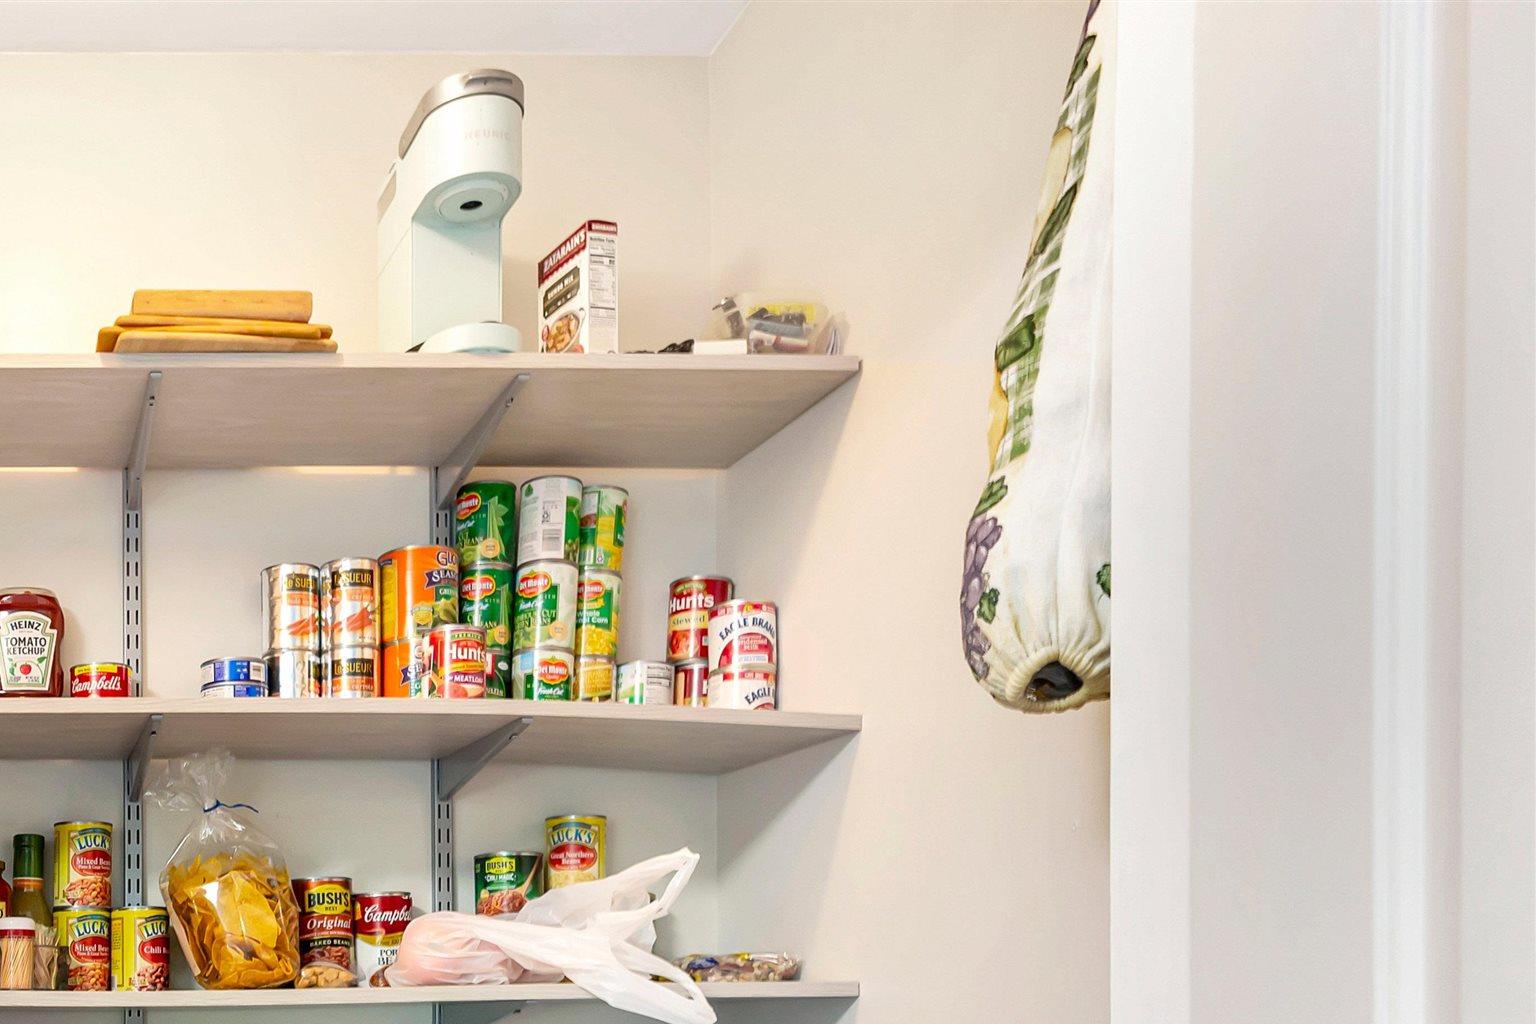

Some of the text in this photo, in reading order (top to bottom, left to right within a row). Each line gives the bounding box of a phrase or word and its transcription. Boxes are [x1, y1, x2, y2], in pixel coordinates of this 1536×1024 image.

[436, 551, 456, 566] Glo
[10, 620, 42, 631] HEINZ
[672, 614, 706, 626] stewd
[5, 636, 47, 647] TOMATO
[6, 646, 46, 656] KETCHUP
[71, 676, 122, 694] Campbell's
[745, 687, 771, 705] EAGL
[551, 829, 593, 845] LUCK'S
[76, 857, 98, 866] Mixed
[486, 860, 514, 871] BUSH'S
[307, 891, 350, 909] BUSH'S
[306, 916, 351, 930] Original
[144, 921, 166, 937] LUC
[74, 944, 97, 952] Mixed
[310, 940, 332, 948] BAKED
[144, 946, 162, 954] Chili
[380, 949, 398, 957] POR
